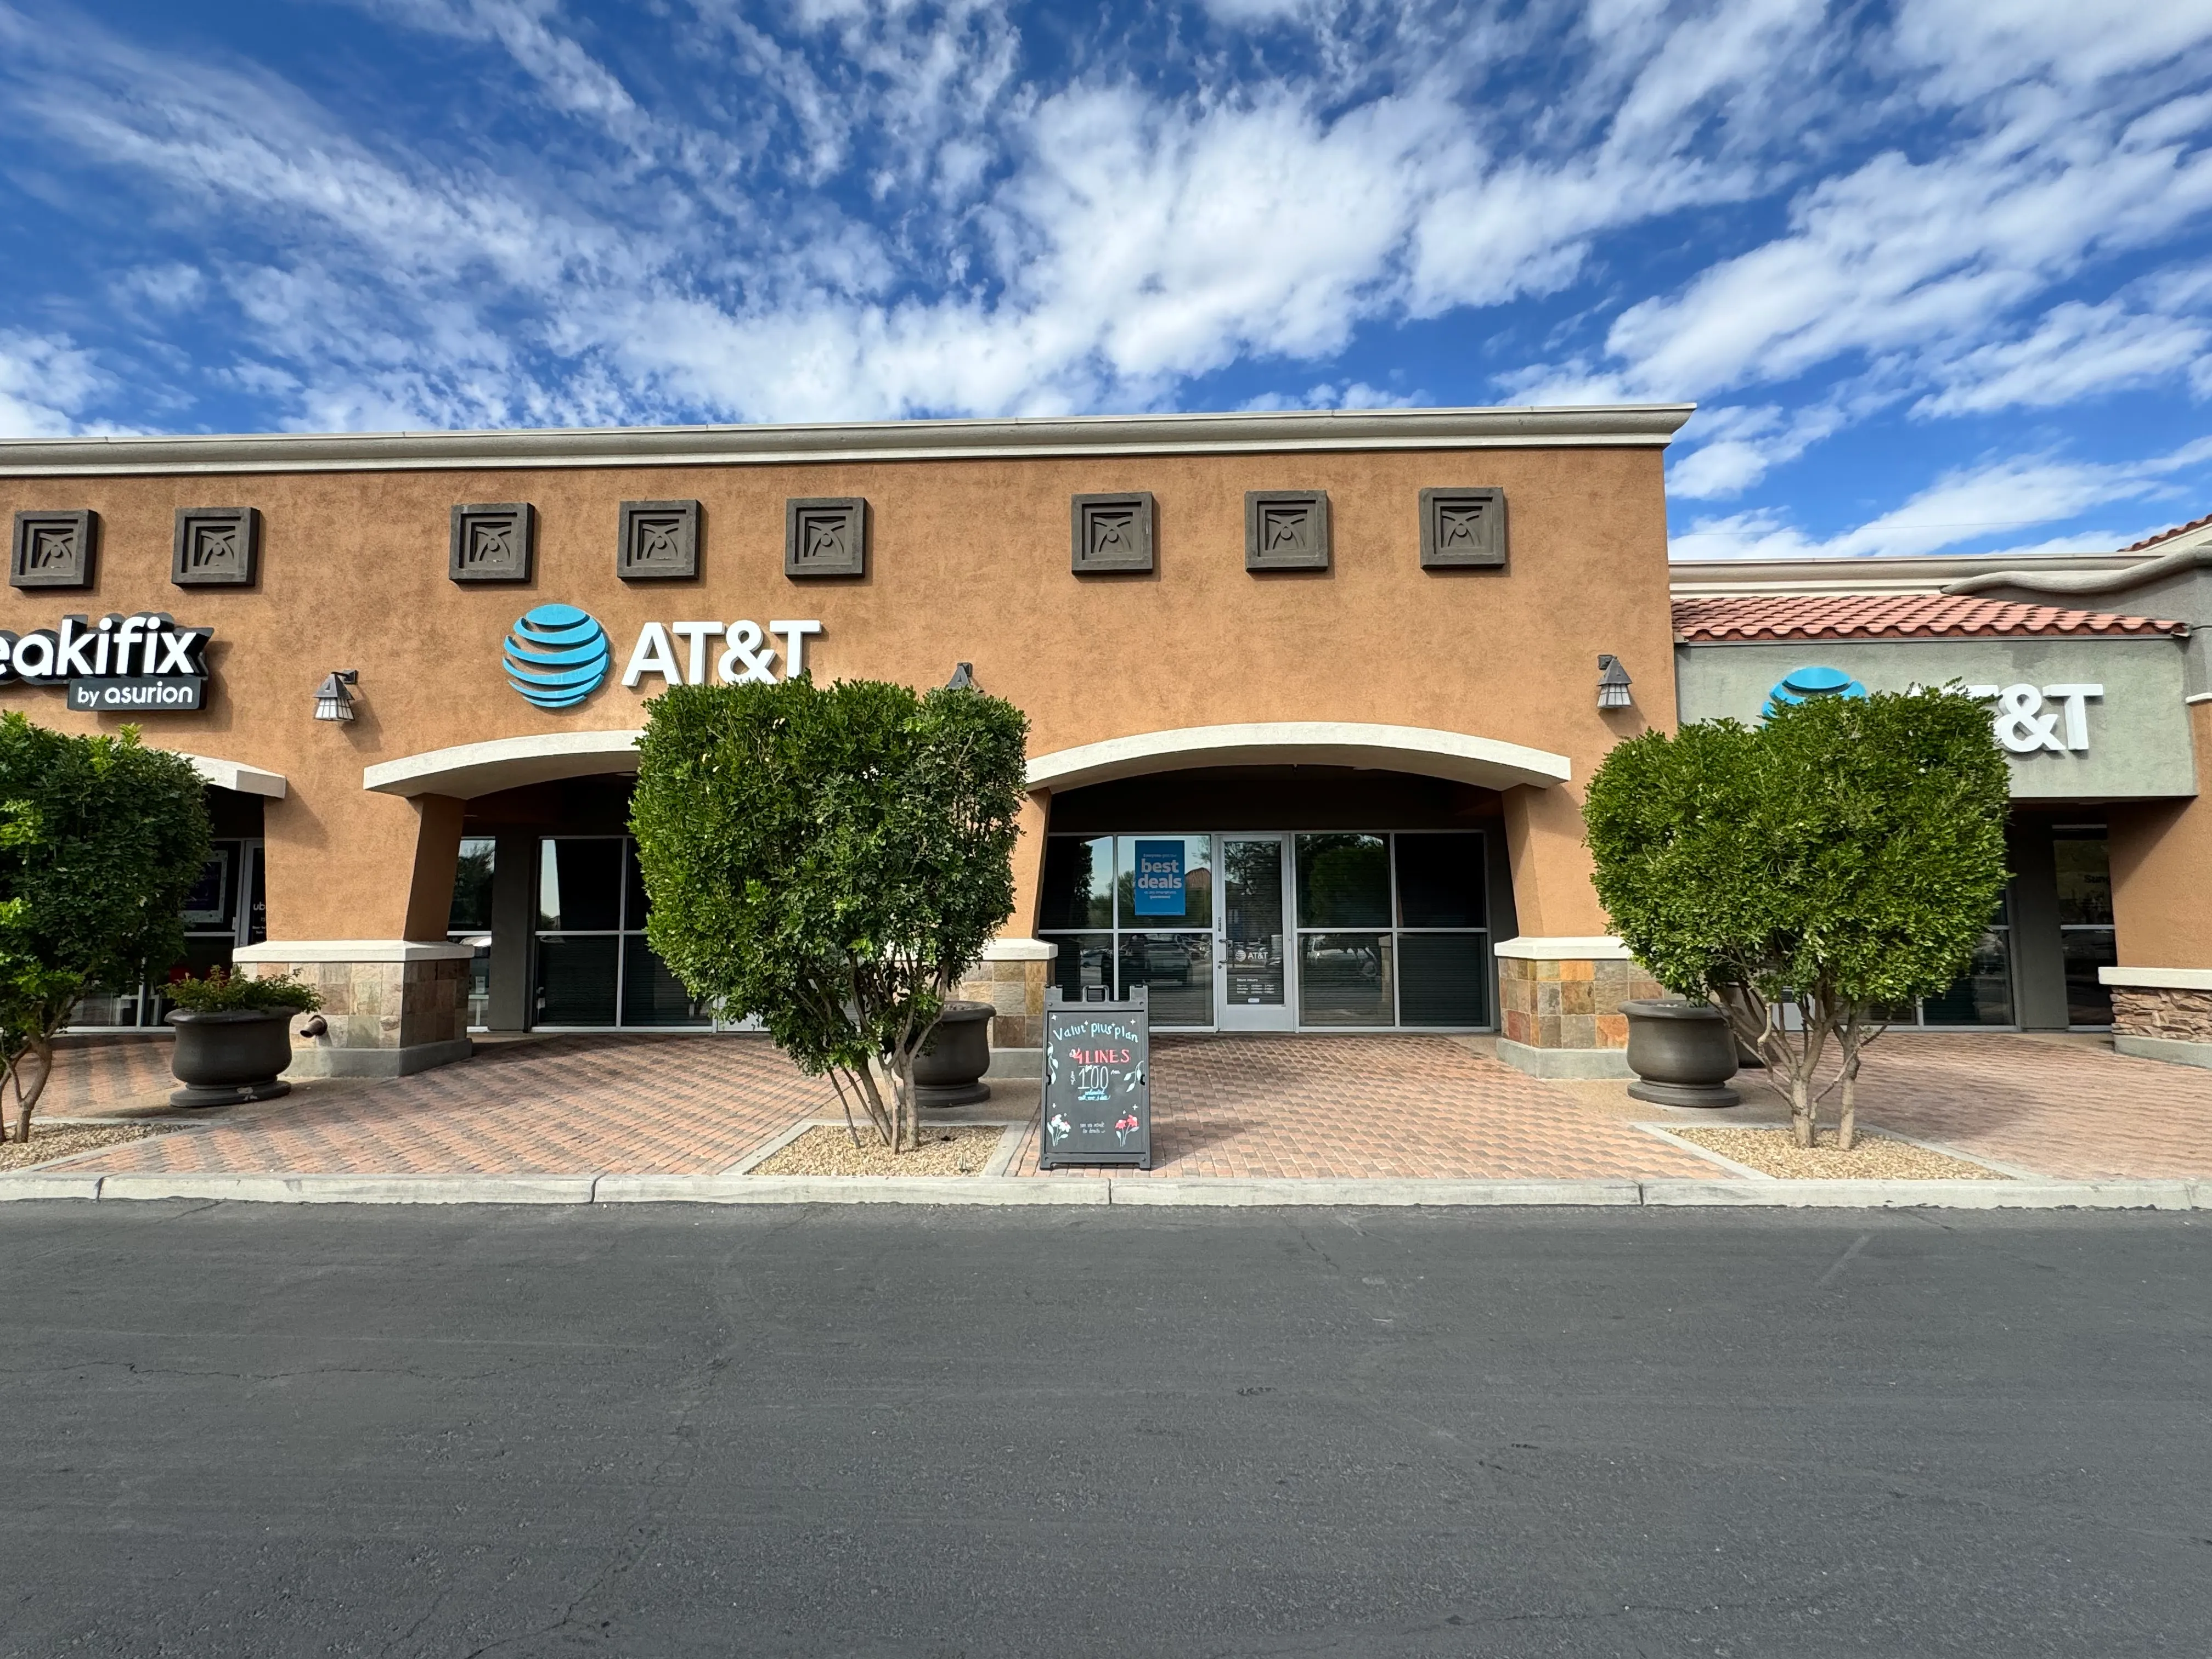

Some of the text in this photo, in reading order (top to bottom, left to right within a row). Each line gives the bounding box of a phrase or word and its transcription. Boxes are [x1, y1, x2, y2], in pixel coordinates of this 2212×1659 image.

[0, 617, 196, 676] akifix
[621, 620, 821, 686] AT&T
[77, 681, 193, 707] by asurion
[1141, 858, 1179, 873] best
[1138, 873, 1182, 889] deals
[1091, 1023, 1112, 1038] plus
[1115, 1025, 1138, 1043] plan
[1086, 1049, 1130, 1063] LINES
